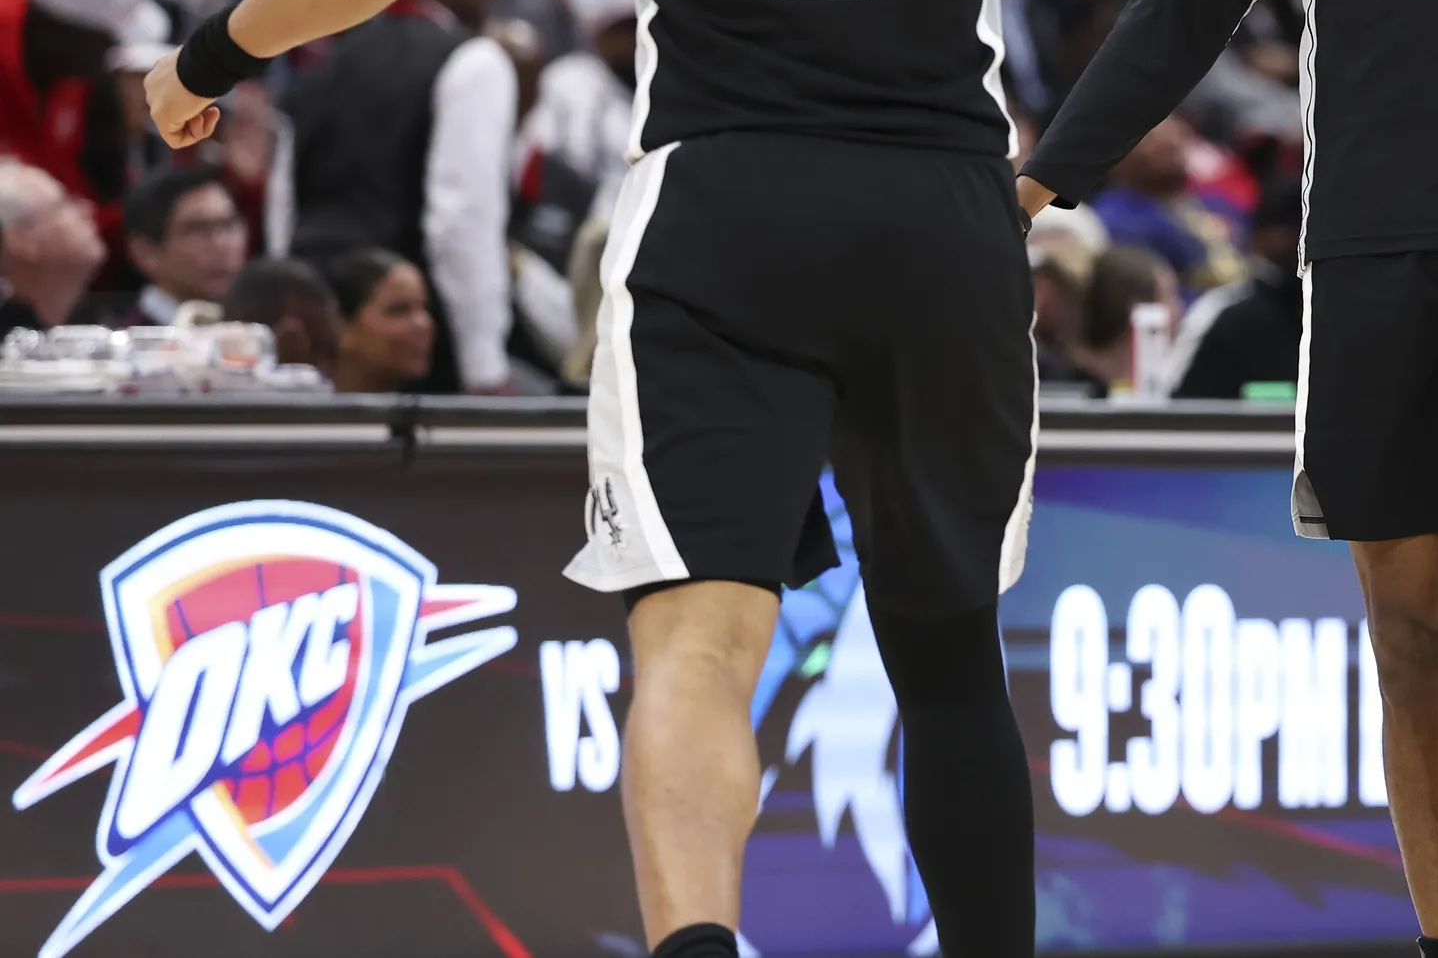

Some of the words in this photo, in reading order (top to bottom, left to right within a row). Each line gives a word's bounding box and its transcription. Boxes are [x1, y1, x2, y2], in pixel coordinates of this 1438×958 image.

[115, 581, 359, 840] OKC
[539, 638, 620, 792] VS
[1050, 583, 1349, 817] 9:30PM
